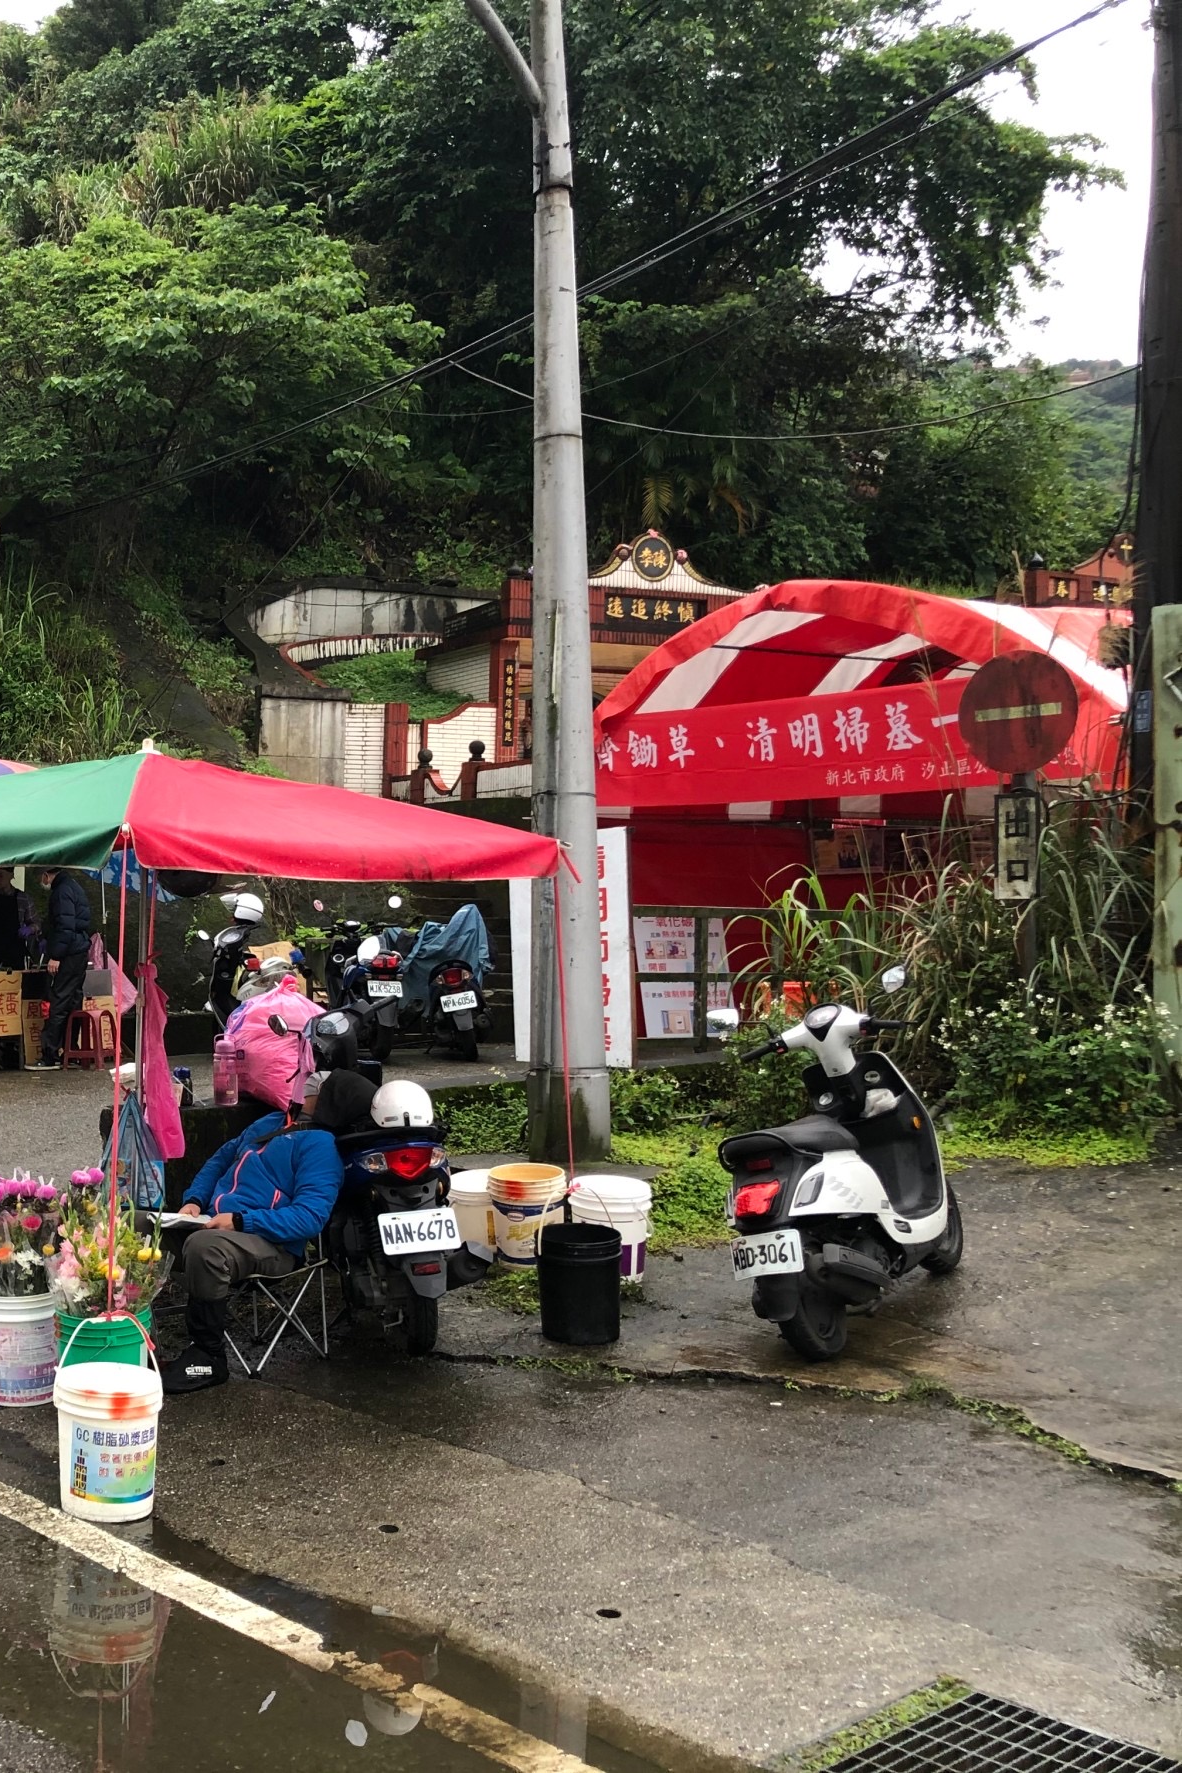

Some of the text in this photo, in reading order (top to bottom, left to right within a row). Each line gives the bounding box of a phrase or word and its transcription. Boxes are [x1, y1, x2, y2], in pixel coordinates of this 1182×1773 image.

[825, 763, 906, 788] 新北市政府
[1005, 810, 1029, 882] 出口
[382, 1218, 456, 1246] NAN-6678
[76, 1427, 89, 1442] GC
